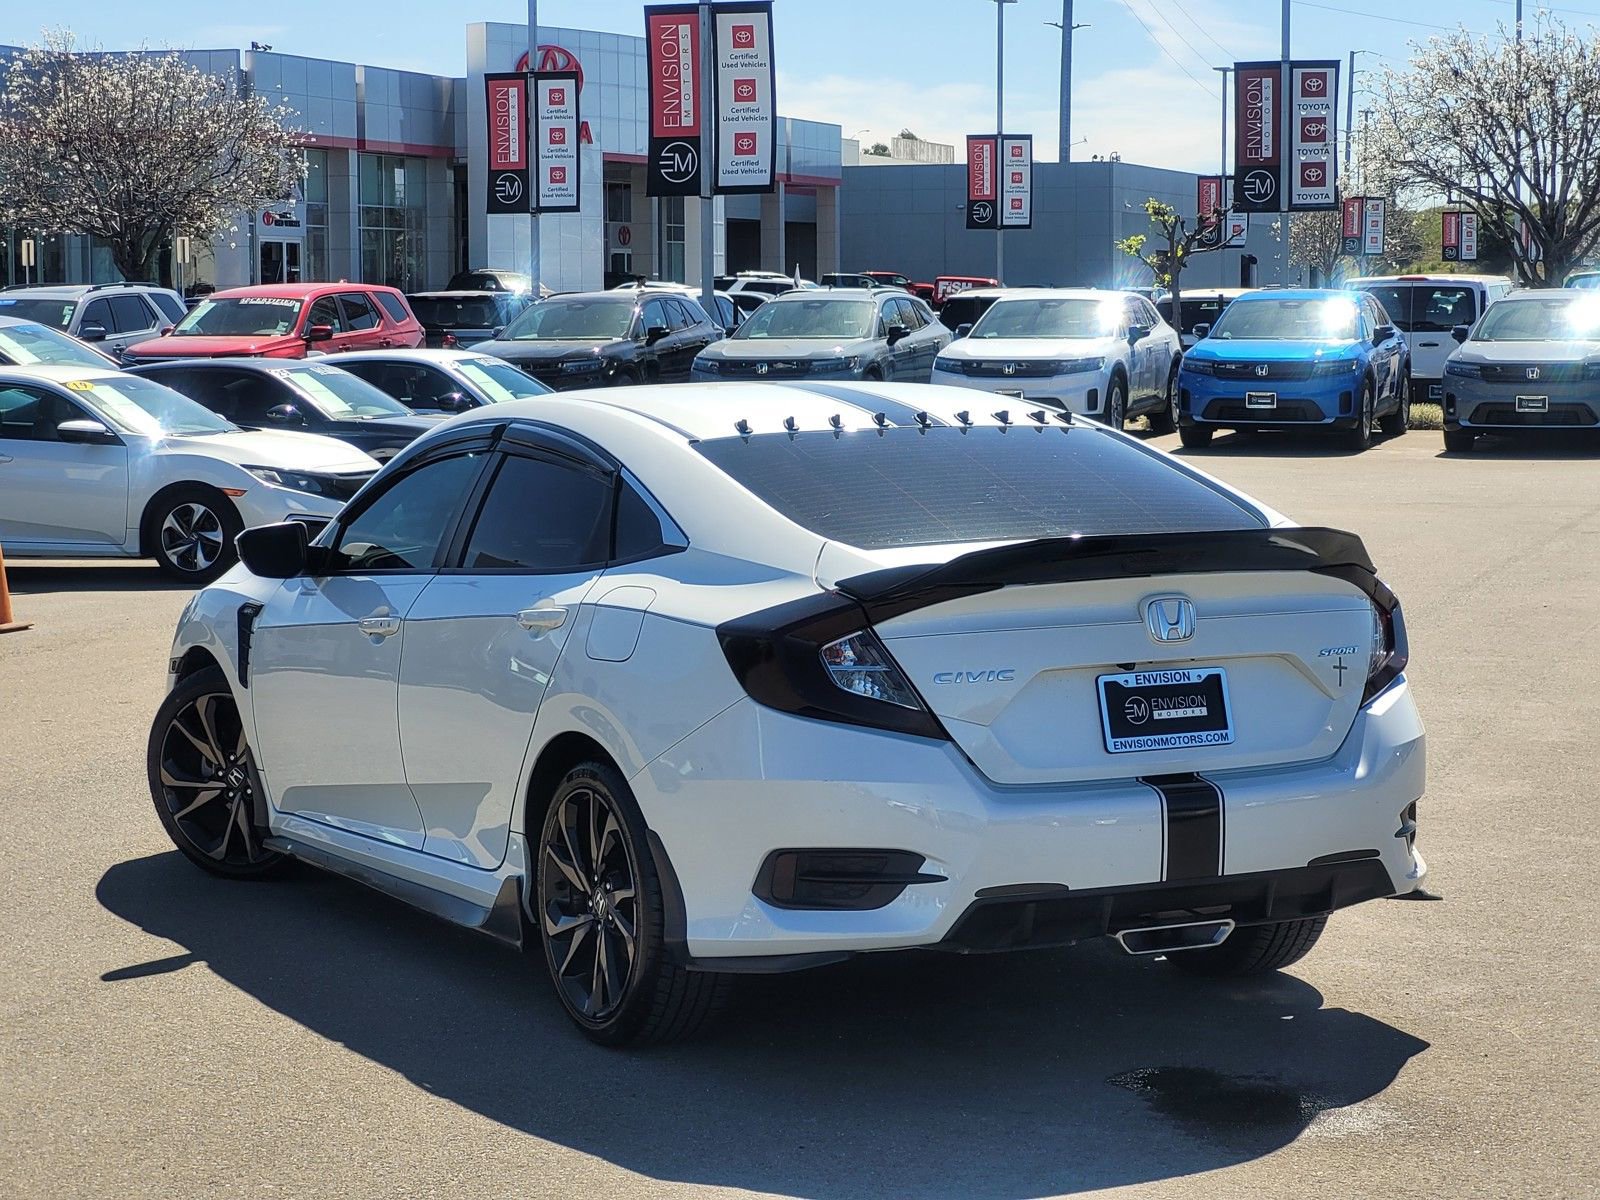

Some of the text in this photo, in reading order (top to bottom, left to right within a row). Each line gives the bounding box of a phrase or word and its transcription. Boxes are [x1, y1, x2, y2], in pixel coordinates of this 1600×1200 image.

[660, 24, 680, 127] ENVISION
[682, 33, 691, 118] MOTORS
[496, 87, 509, 163] ENVISION
[1247, 78, 1261, 158] ENVISION
[974, 144, 984, 196] ENVISION
[1318, 646, 1359, 657] SPORT
[933, 669, 1016, 684] CIVIC
[1135, 671, 1191, 685] ENVISION
[1151, 695, 1207, 710] ENVISION
[1113, 732, 1229, 750] ENVISIONMOTORS.COM
